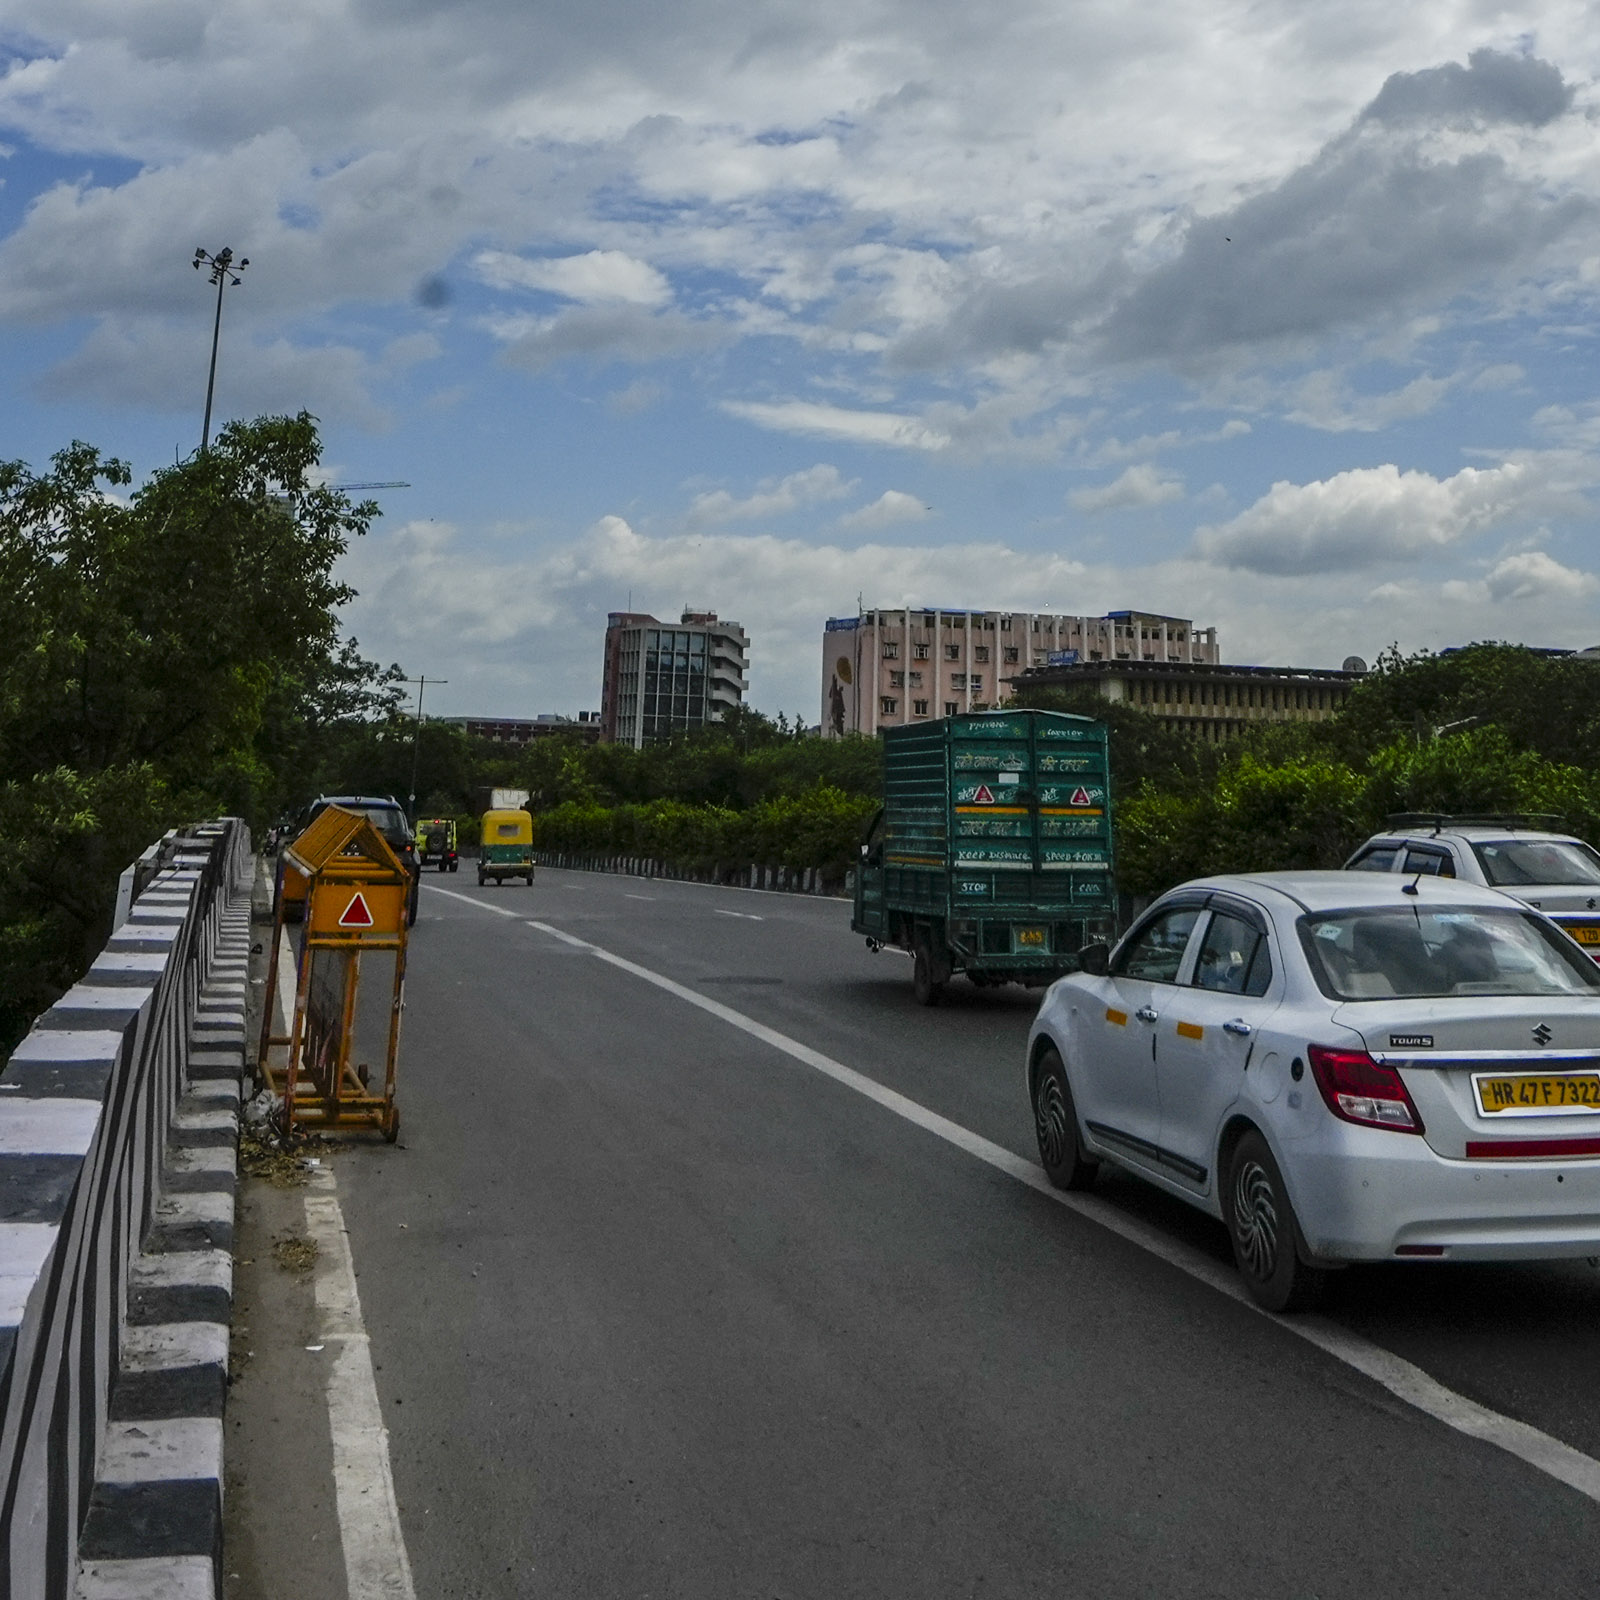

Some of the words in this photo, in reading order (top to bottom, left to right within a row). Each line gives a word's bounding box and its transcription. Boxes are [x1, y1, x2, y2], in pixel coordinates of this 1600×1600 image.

[960, 882, 987, 892] STOP
[1491, 1081, 1515, 1104] HR
[1519, 1081, 1538, 1104] 47
[1542, 1080, 1552, 1104] F
